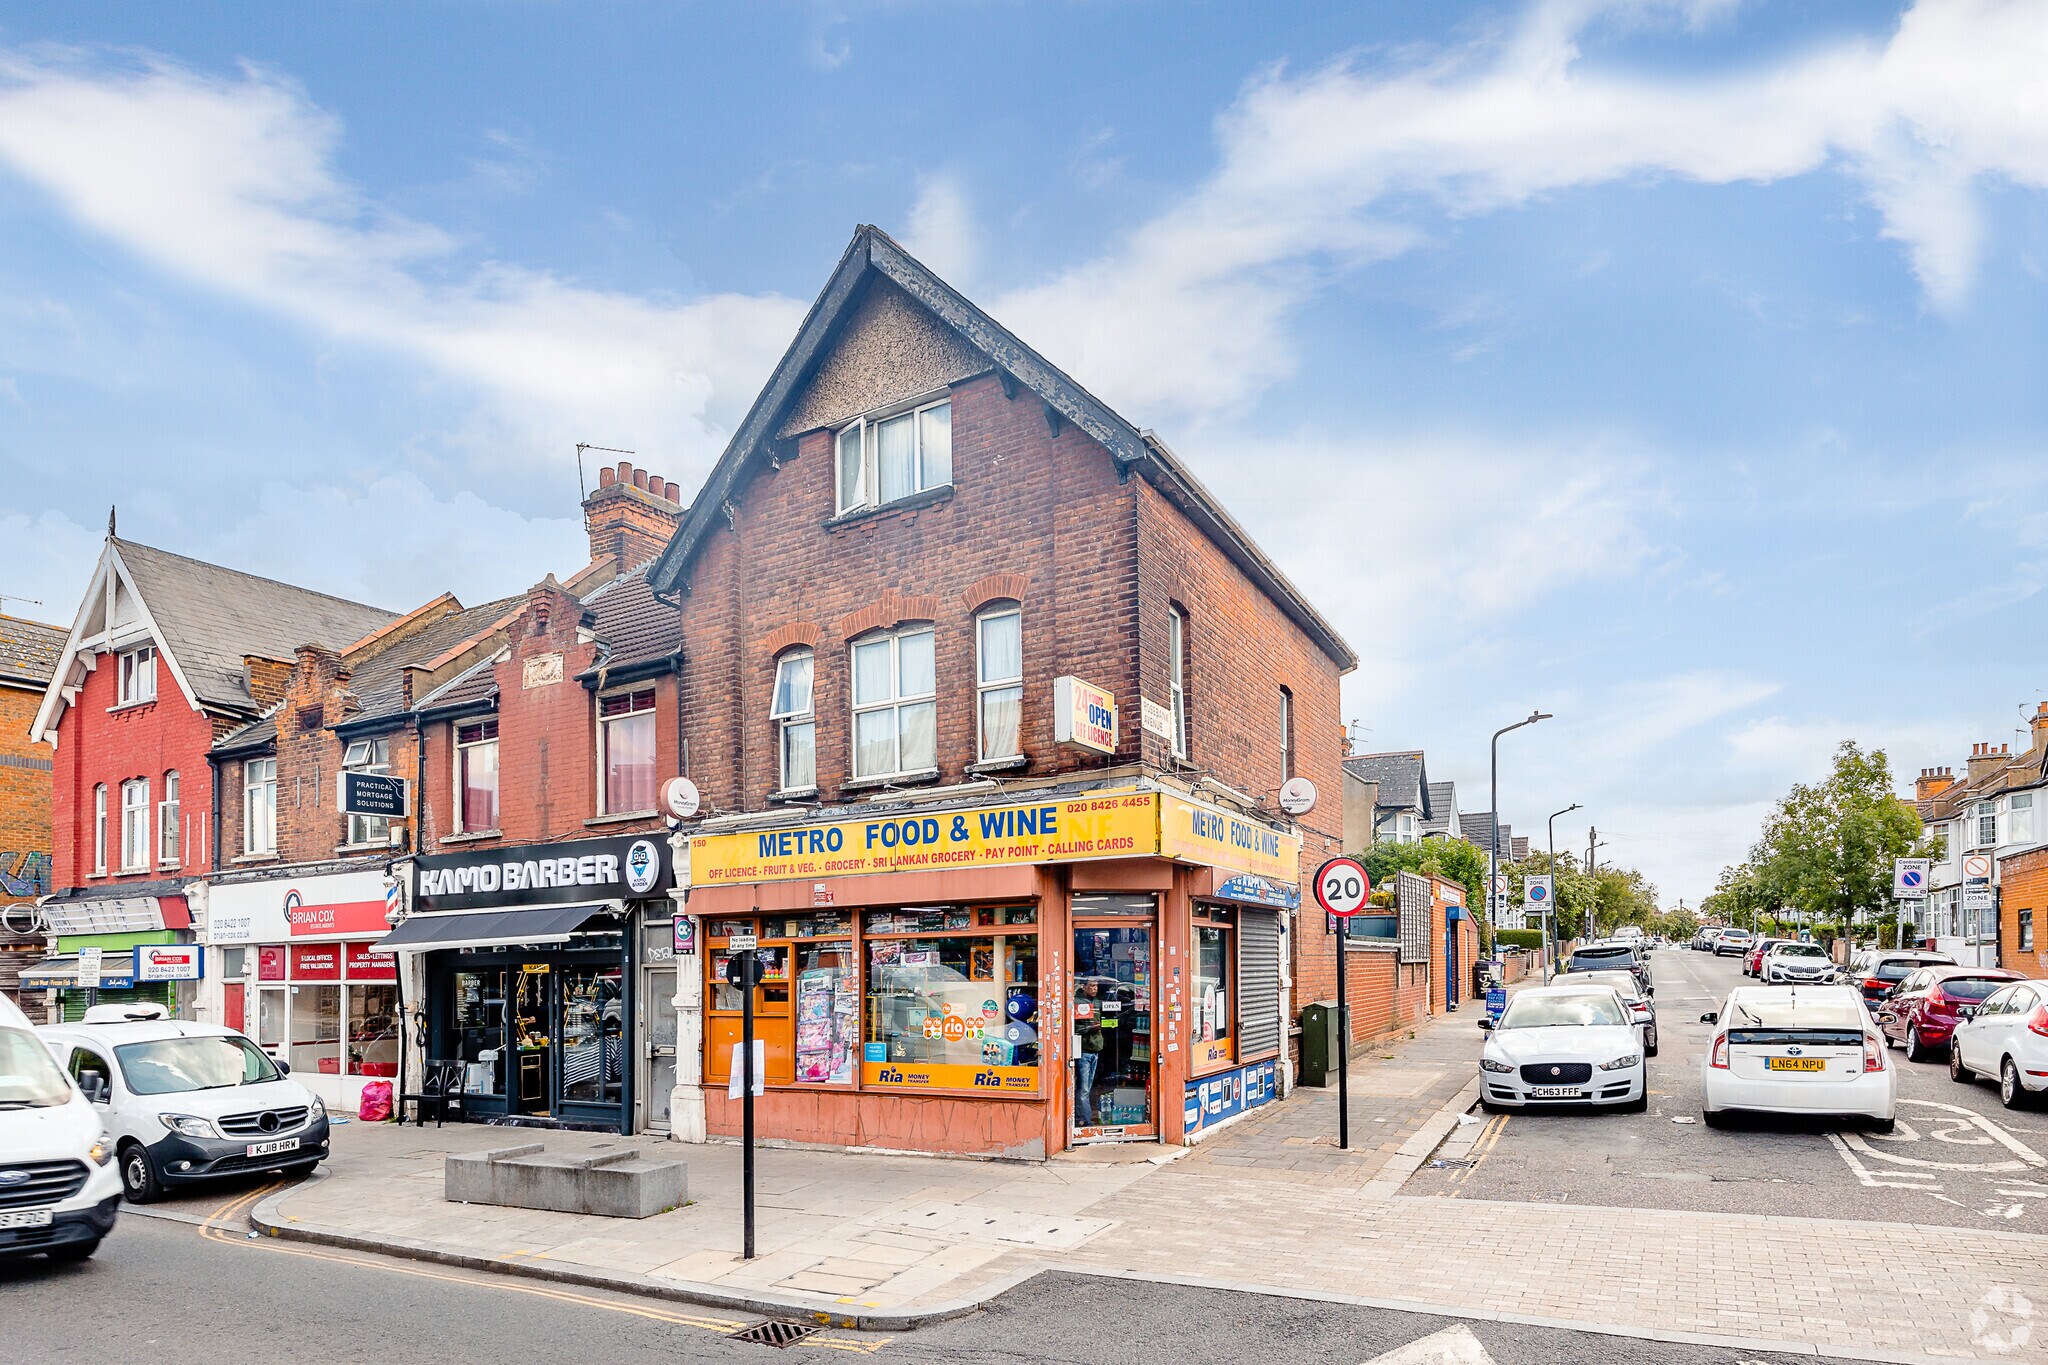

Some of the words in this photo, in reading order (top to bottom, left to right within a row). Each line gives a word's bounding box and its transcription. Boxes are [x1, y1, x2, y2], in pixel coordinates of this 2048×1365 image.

[1075, 686, 1088, 714] 24
[1089, 703, 1112, 731] OPEN
[1143, 701, 1169, 722] ROSEBANK
[1075, 721, 1086, 738] OFF
[1144, 715, 1163, 732] AVENUE
[356, 781, 393, 791] PRACTICAL
[356, 790, 393, 800] MORTGAGE
[356, 800, 394, 809] SOLUTIONS
[1067, 803, 1088, 813] 020
[1091, 800, 1118, 811] 8426
[1121, 797, 1151, 808] 4455
[759, 828, 843, 858] METRO
[866, 818, 939, 849] FOOD
[950, 815, 970, 842] &
[980, 807, 1058, 839] WINE
[1192, 810, 1224, 842] METRO
[1230, 822, 1252, 849] FOOD
[1254, 829, 1260, 851] &
[1261, 831, 1279, 857] WINE
[692, 839, 707, 848] 150
[709, 869, 723, 879] OFF
[724, 866, 758, 878] LICENCE
[763, 864, 787, 876] FRUIT
[789, 864, 796, 874] &
[797, 862, 817, 873] VEG.
[825, 858, 865, 871] GROCERY
[872, 856, 887, 868] SRI
[890, 853, 928, 867] LANKAN
[931, 850, 976, 863] GROCERY
[985, 847, 1005, 859] PAY
[1010, 844, 1039, 857] POINT
[1048, 839, 1094, 855] CALLING
[1097, 837, 1134, 850] CARDS
[420, 864, 501, 896] KAMO
[502, 854, 619, 891] BARBER
[1327, 877, 1361, 901] 20
[214, 919, 223, 929] 020
[224, 918, 237, 929] 8422
[238, 917, 250, 928] 1007
[292, 911, 317, 923] BRIAN
[318, 909, 335, 922] COX
[214, 929, 250, 940] brian-cox.co.uk
[1311, 1013, 1317, 1021] 4
[944, 1018, 963, 1033] ria
[1208, 1044, 1217, 1061] Ria
[1771, 1060, 1799, 1069] LN64
[1802, 1060, 1824, 1069] NPU
[879, 1066, 903, 1083] Ria
[974, 1069, 1001, 1087] Ria
[1536, 1087, 1561, 1097] CH63
[1562, 1087, 1580, 1096] FFF
[256, 1142, 277, 1154] KJ18
[279, 1140, 297, 1151] HRW
